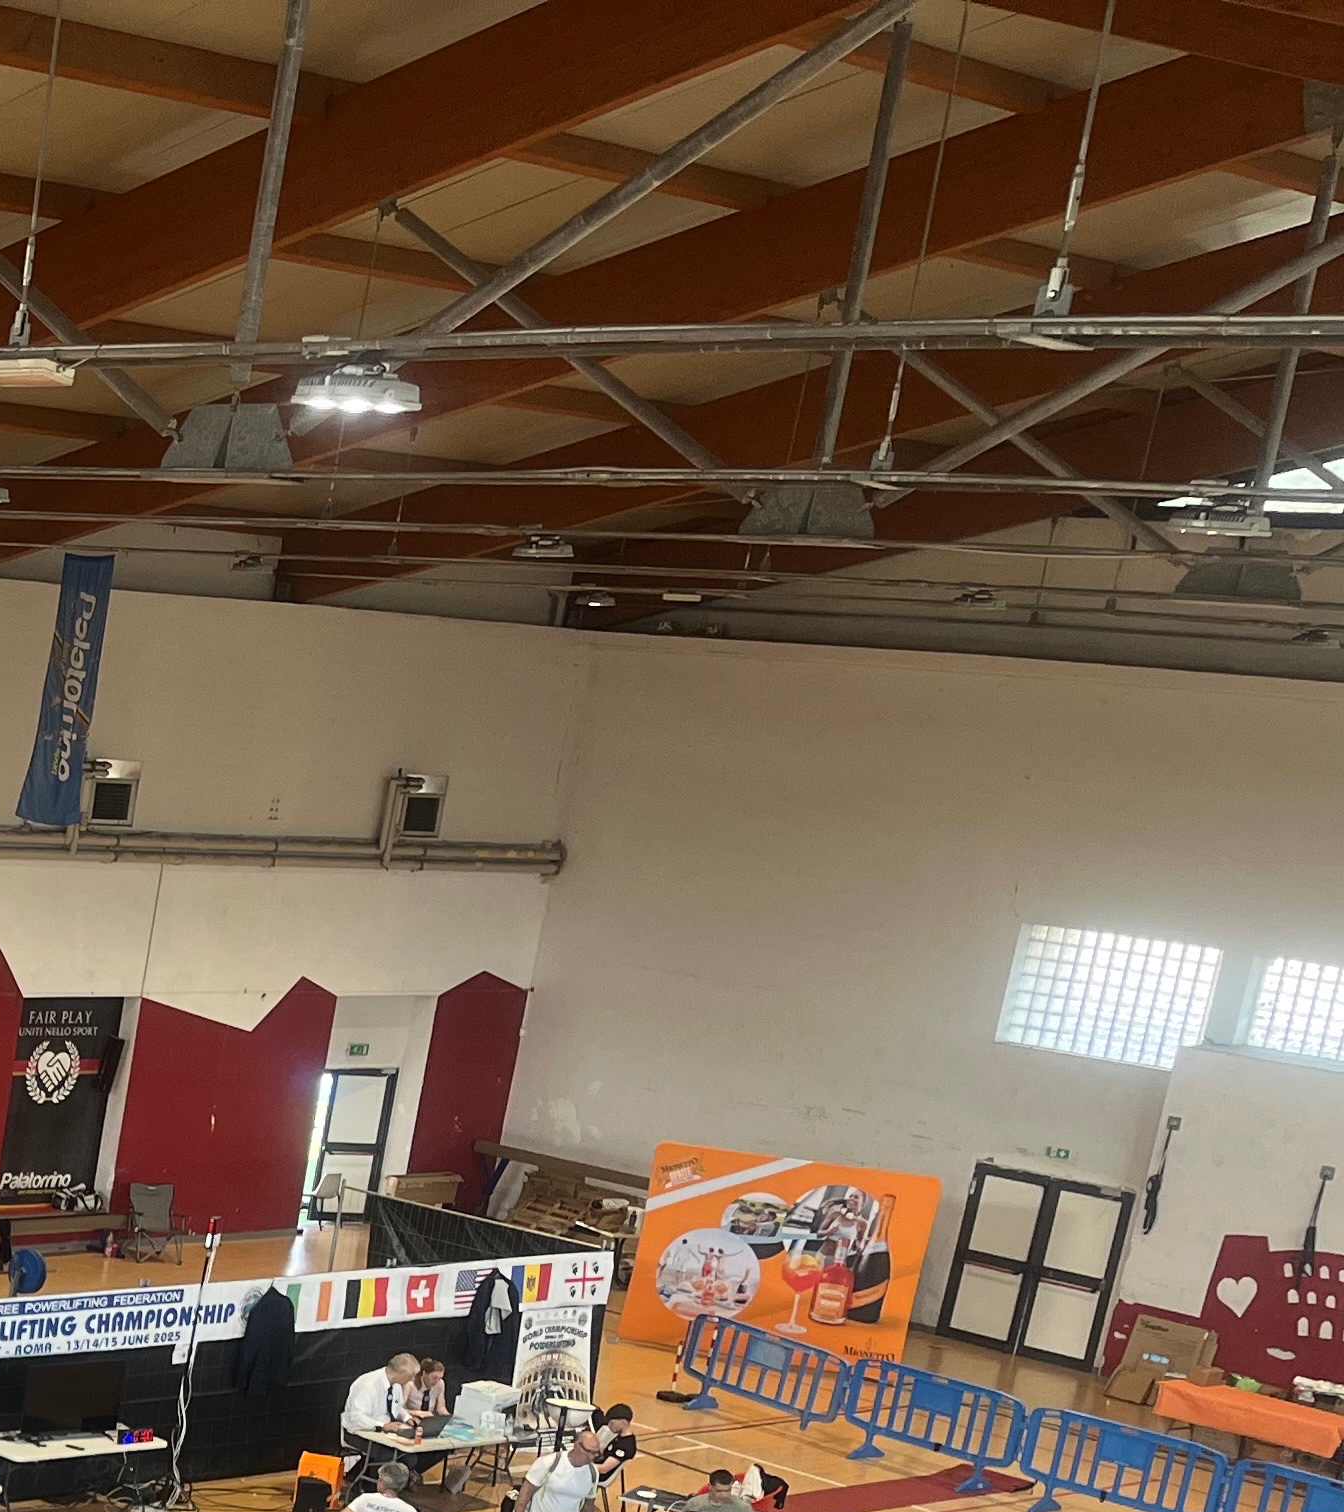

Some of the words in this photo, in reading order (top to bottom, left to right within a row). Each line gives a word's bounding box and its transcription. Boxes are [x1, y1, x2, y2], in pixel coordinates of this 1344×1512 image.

[58, 591, 97, 782] Palatorrino
[28, 1010, 56, 1024] FAIR
[61, 1010, 92, 1024] PLAY
[18, 1026, 42, 1037] UNITI
[44, 1026, 71, 1036] NELLO
[72, 1026, 99, 1036] SPORT
[0, 1171, 72, 1190] Palatorrino
[24, 1297, 108, 1314] POWERLIFTING
[113, 1290, 181, 1306] FEDERATION
[85, 1303, 235, 1334] CHAMPIONSHIP
[15, 1344, 52, 1356] ROMA
[66, 1337, 118, 1351] 13/14/15
[121, 1333, 149, 1346] JUNE
[153, 1331, 181, 1343] 2025
